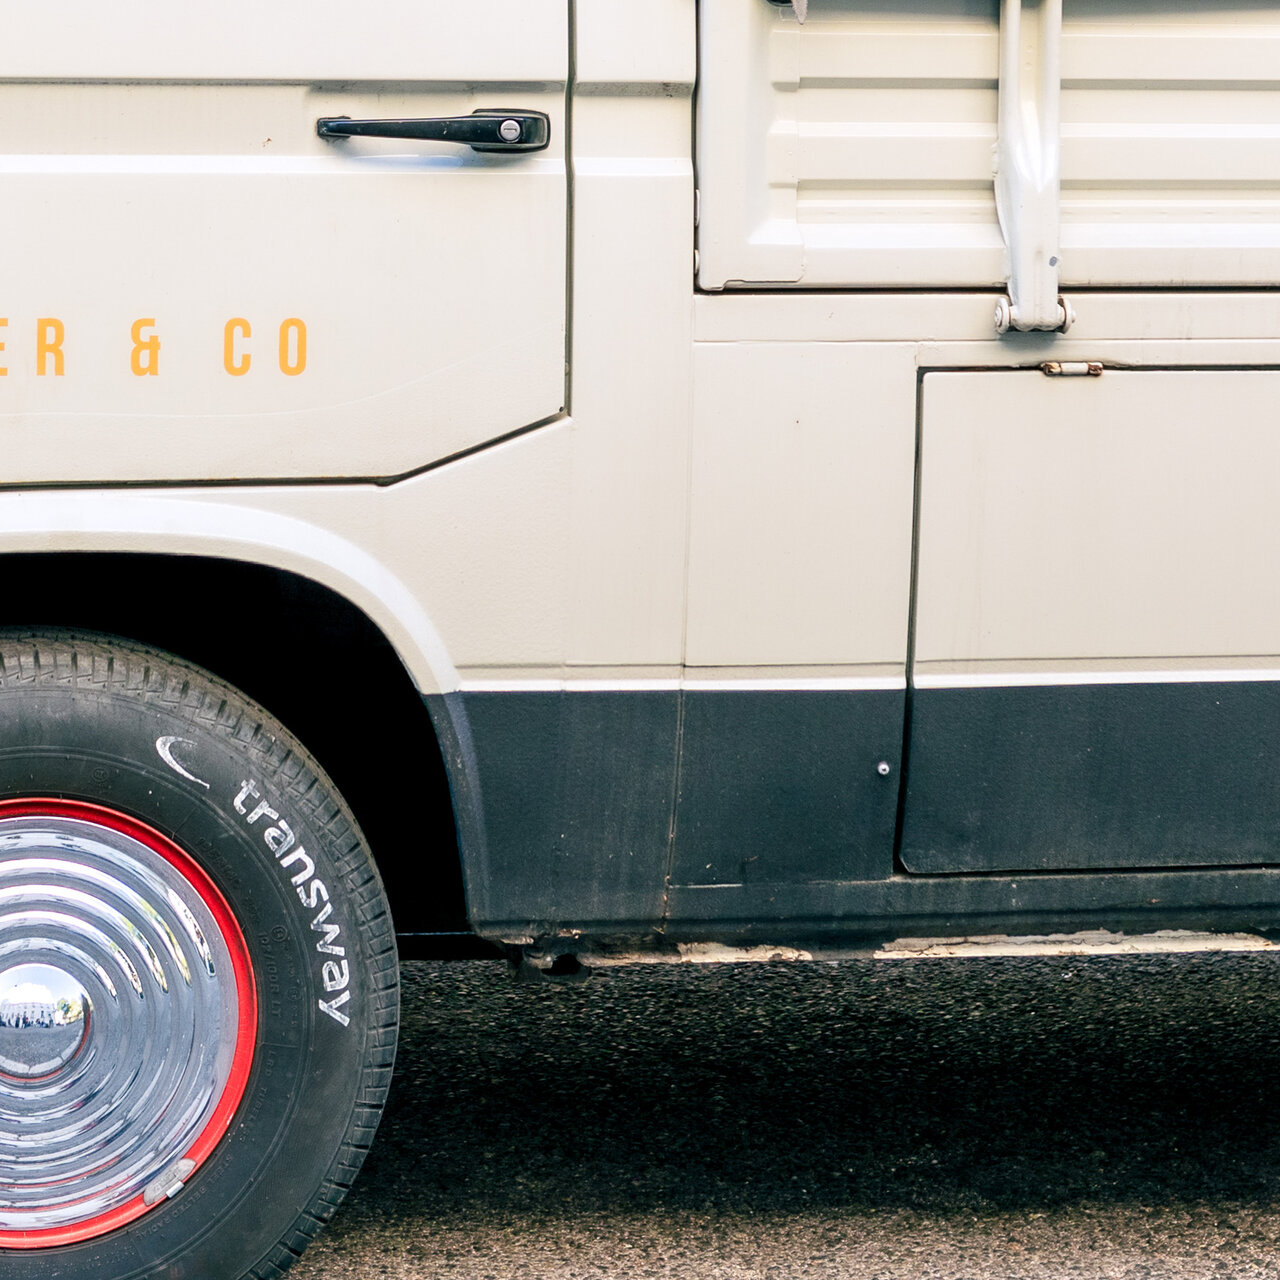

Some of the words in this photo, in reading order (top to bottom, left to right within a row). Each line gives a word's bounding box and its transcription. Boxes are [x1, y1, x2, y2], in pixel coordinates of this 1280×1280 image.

[129, 318, 162, 378] &
[222, 317, 308, 378] CO
[232, 778, 352, 1028] transway
